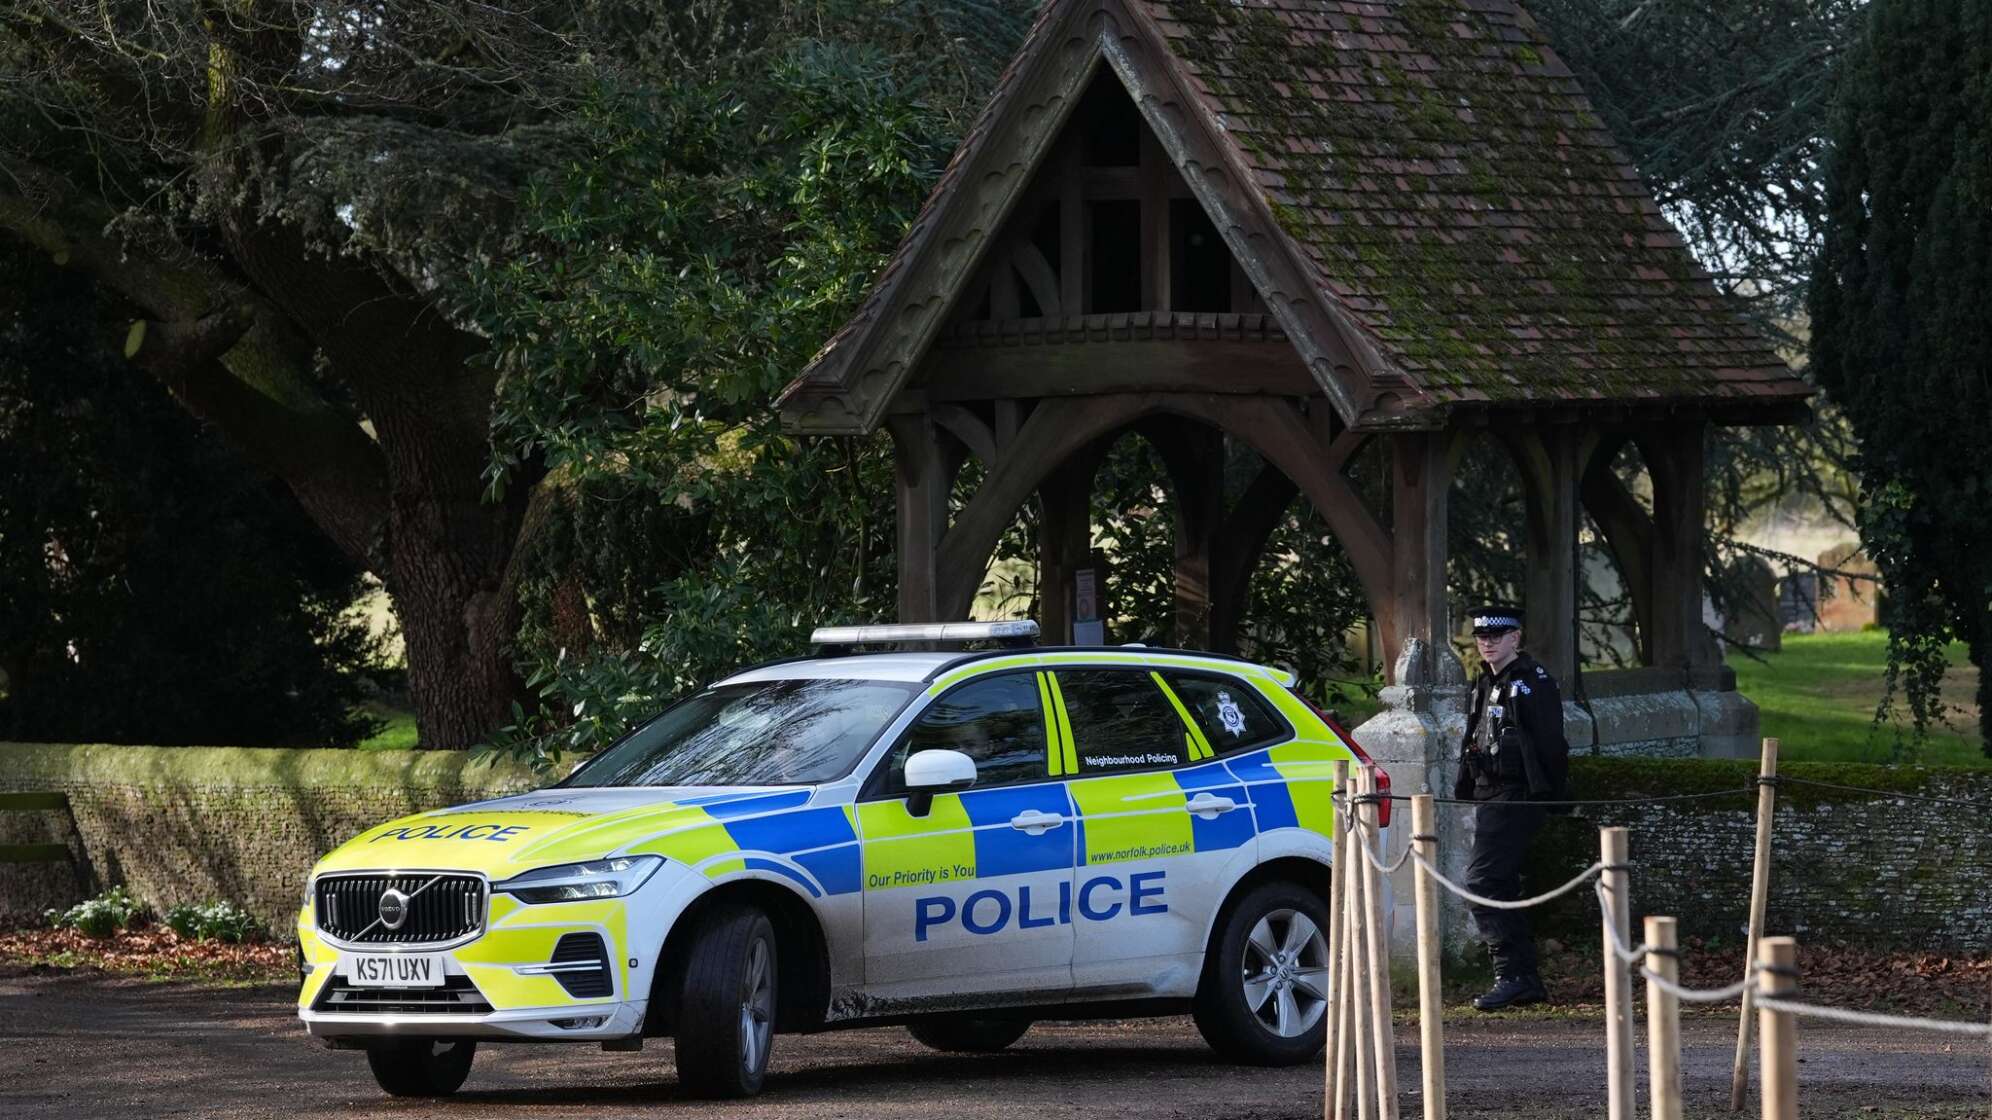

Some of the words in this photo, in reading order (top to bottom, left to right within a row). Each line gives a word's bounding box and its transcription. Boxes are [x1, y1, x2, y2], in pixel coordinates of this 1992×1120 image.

[1085, 754, 1145, 767] Neighbourhood
[1146, 753, 1178, 764] Policing
[369, 824, 531, 843] POLICE
[1091, 841, 1190, 862] www.norfolk.police.uk
[869, 874, 891, 888] Our
[894, 869, 936, 884] Priority
[939, 867, 950, 879] is
[953, 864, 975, 877] You
[915, 870, 1168, 942] POLICE
[356, 958, 394, 981] KS71
[397, 958, 430, 981] UXV
